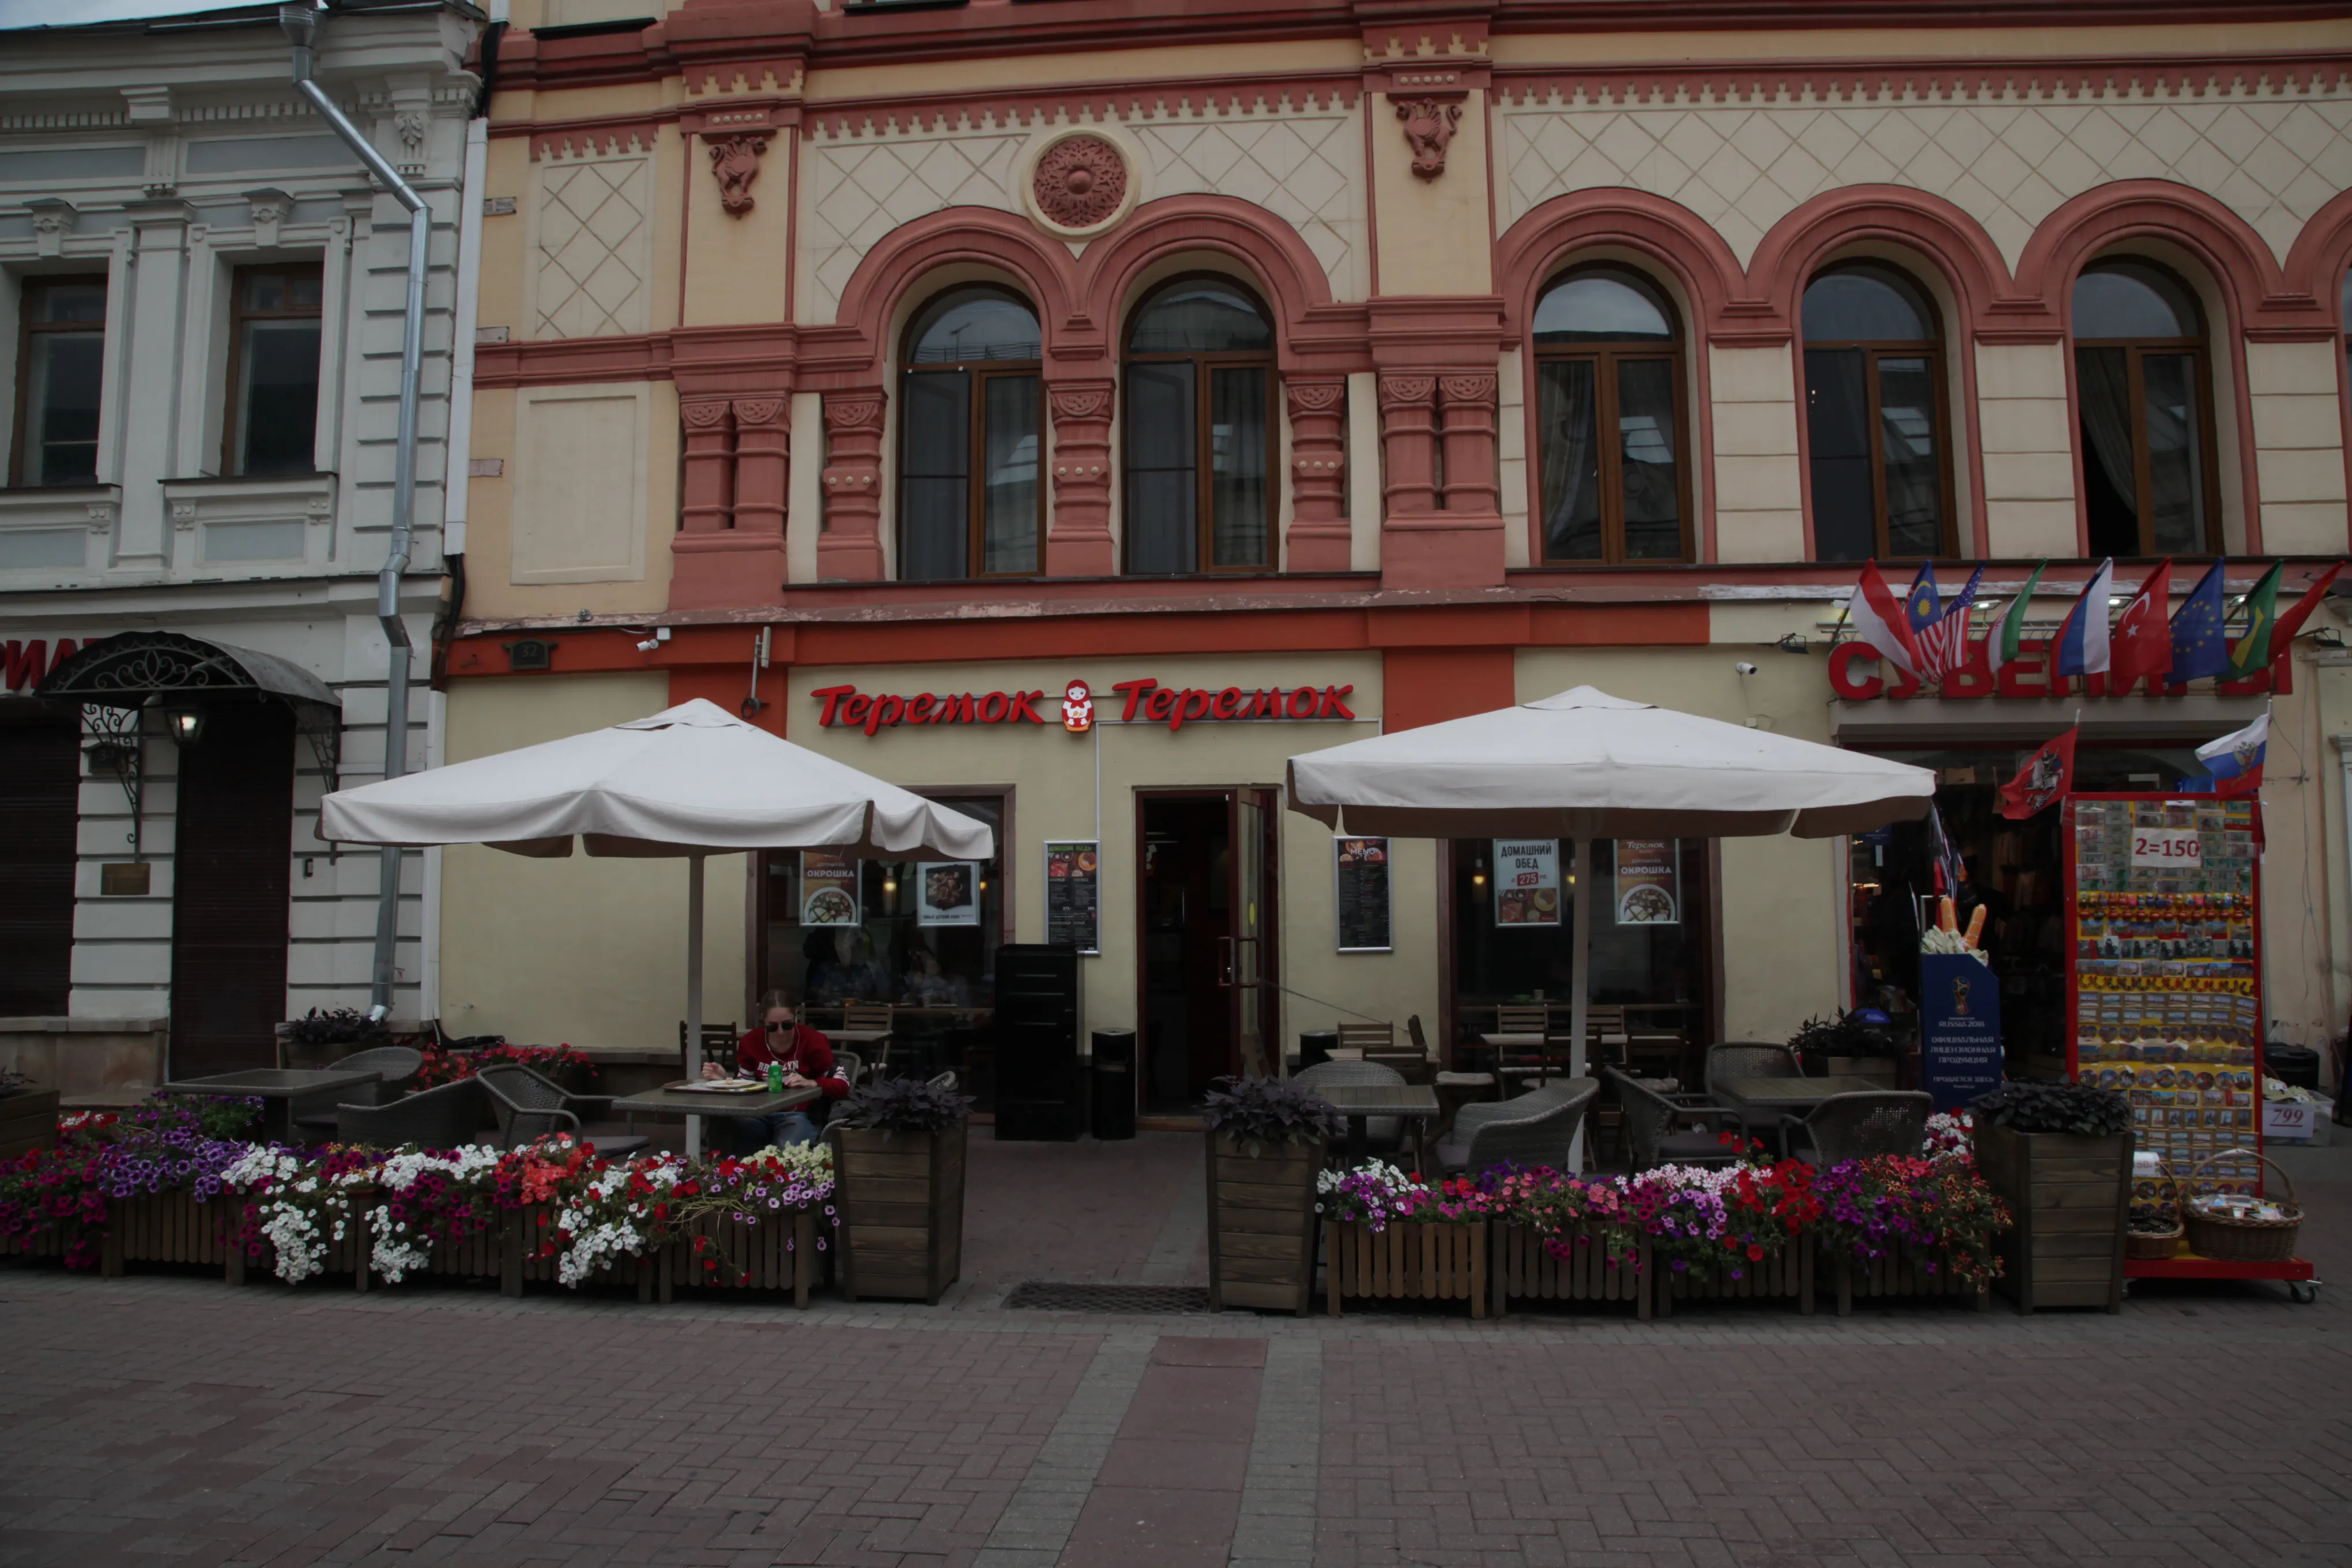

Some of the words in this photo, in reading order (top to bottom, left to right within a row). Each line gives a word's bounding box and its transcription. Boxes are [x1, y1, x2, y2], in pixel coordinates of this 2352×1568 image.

[521, 644, 537, 658] 32
[811, 684, 1045, 737] Теремок
[1111, 678, 1355, 731] Теремок
[1501, 842, 1551, 858] ДОМАШНИЙ
[1626, 841, 1665, 850] Теремок
[2135, 838, 2200, 857] 2=150
[1516, 858, 1539, 869] ОБЕД
[1621, 866, 1672, 875] ОКРОШКА
[1520, 874, 1536, 885] 275
[2273, 1109, 2304, 1124] 799
